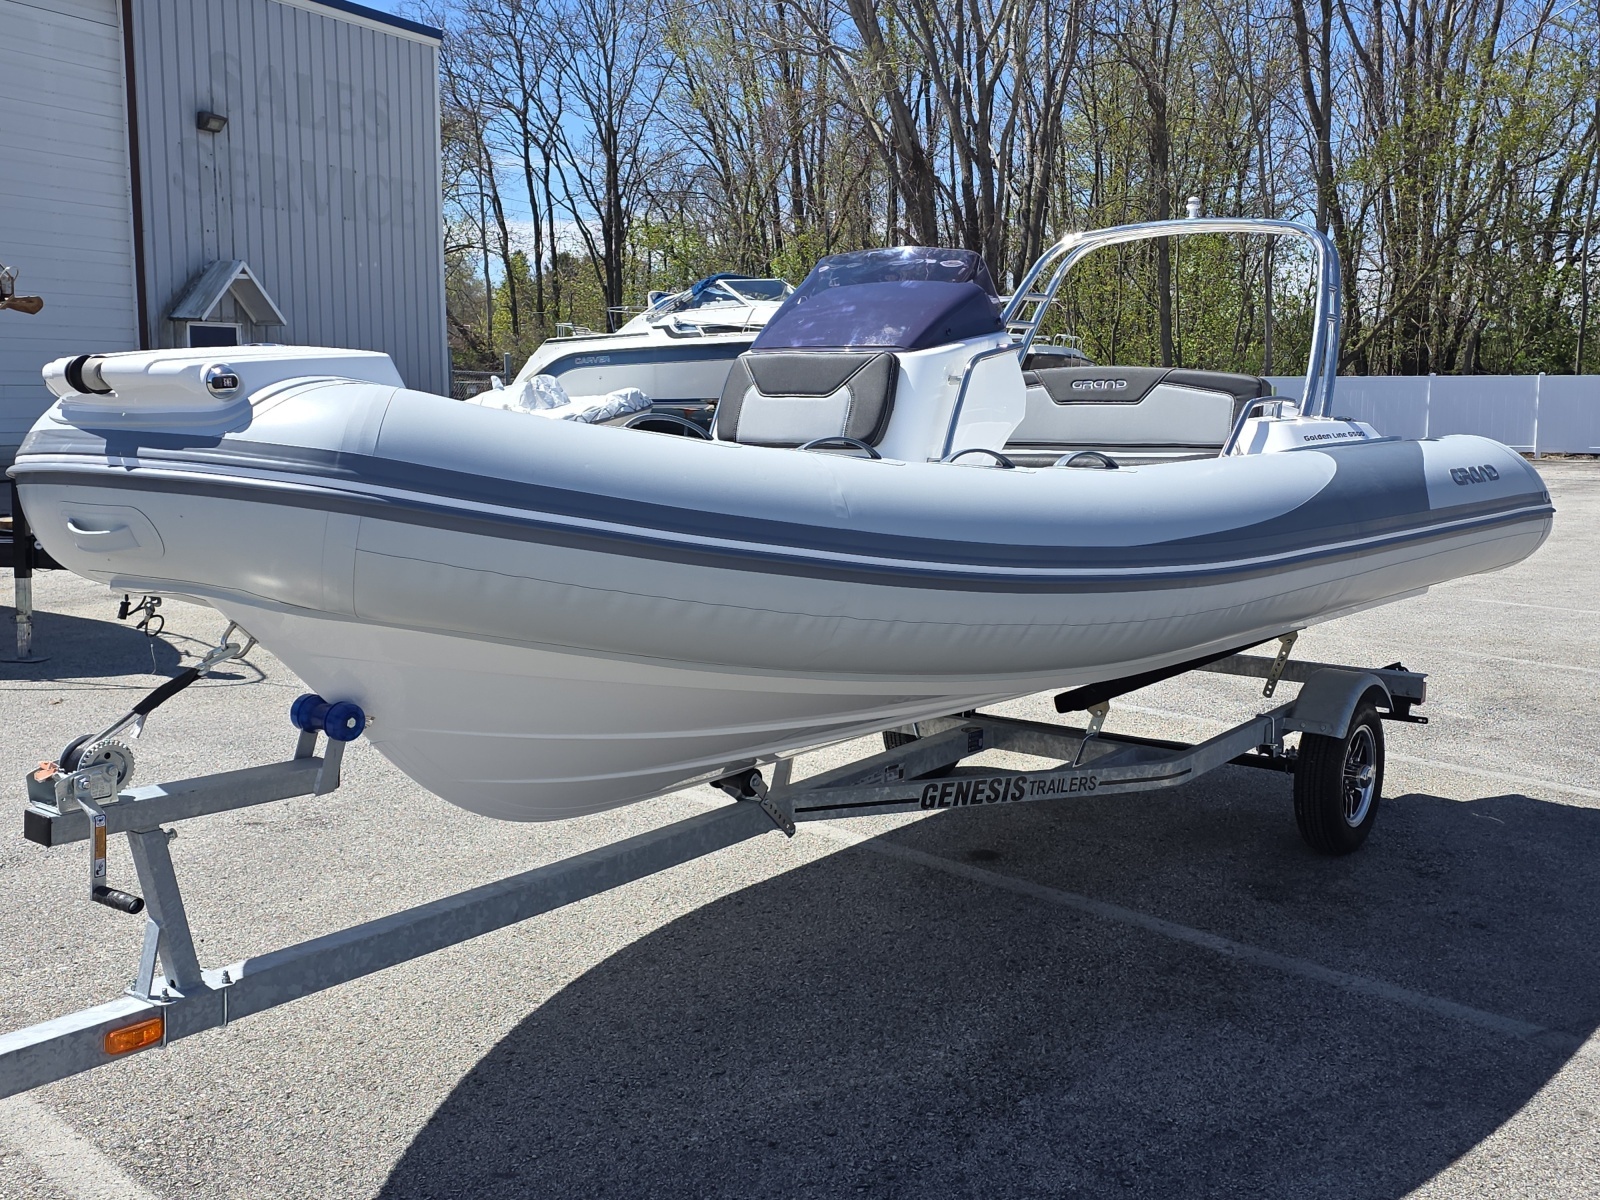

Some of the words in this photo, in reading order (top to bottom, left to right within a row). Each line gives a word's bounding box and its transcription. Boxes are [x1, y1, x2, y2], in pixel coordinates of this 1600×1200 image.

[205, 50, 391, 143] SALES
[574, 355, 611, 365] CARVER
[1071, 379, 1128, 390] GRAND
[1303, 433, 1332, 442] Golden
[1449, 464, 1500, 486] GRAND
[920, 776, 1028, 810] GENESIS
[1029, 775, 1097, 796] TRAILERS
